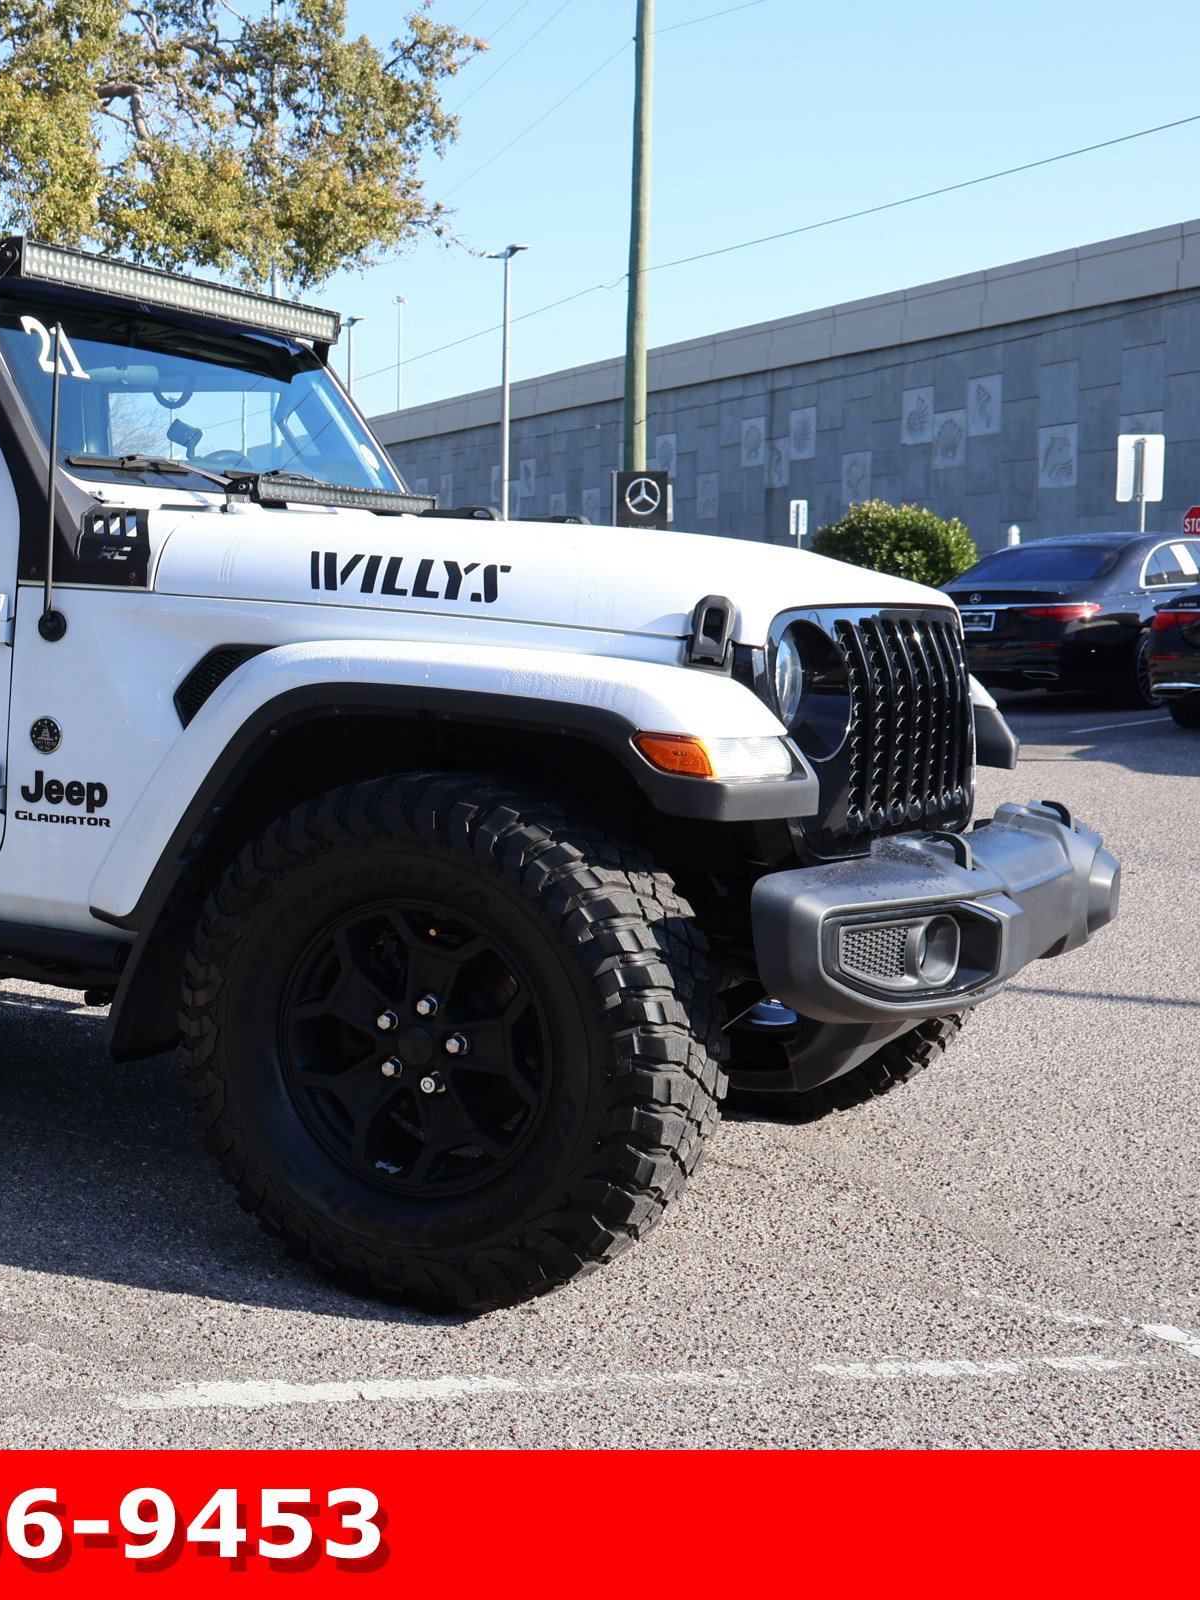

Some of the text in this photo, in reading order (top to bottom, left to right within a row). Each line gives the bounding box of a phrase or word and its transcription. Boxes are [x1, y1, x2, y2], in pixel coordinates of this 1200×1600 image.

[20, 315, 90, 379] 21
[310, 550, 512, 604] WILLYS
[20, 770, 108, 814] Jeep
[14, 810, 111, 828] GLADIATOR
